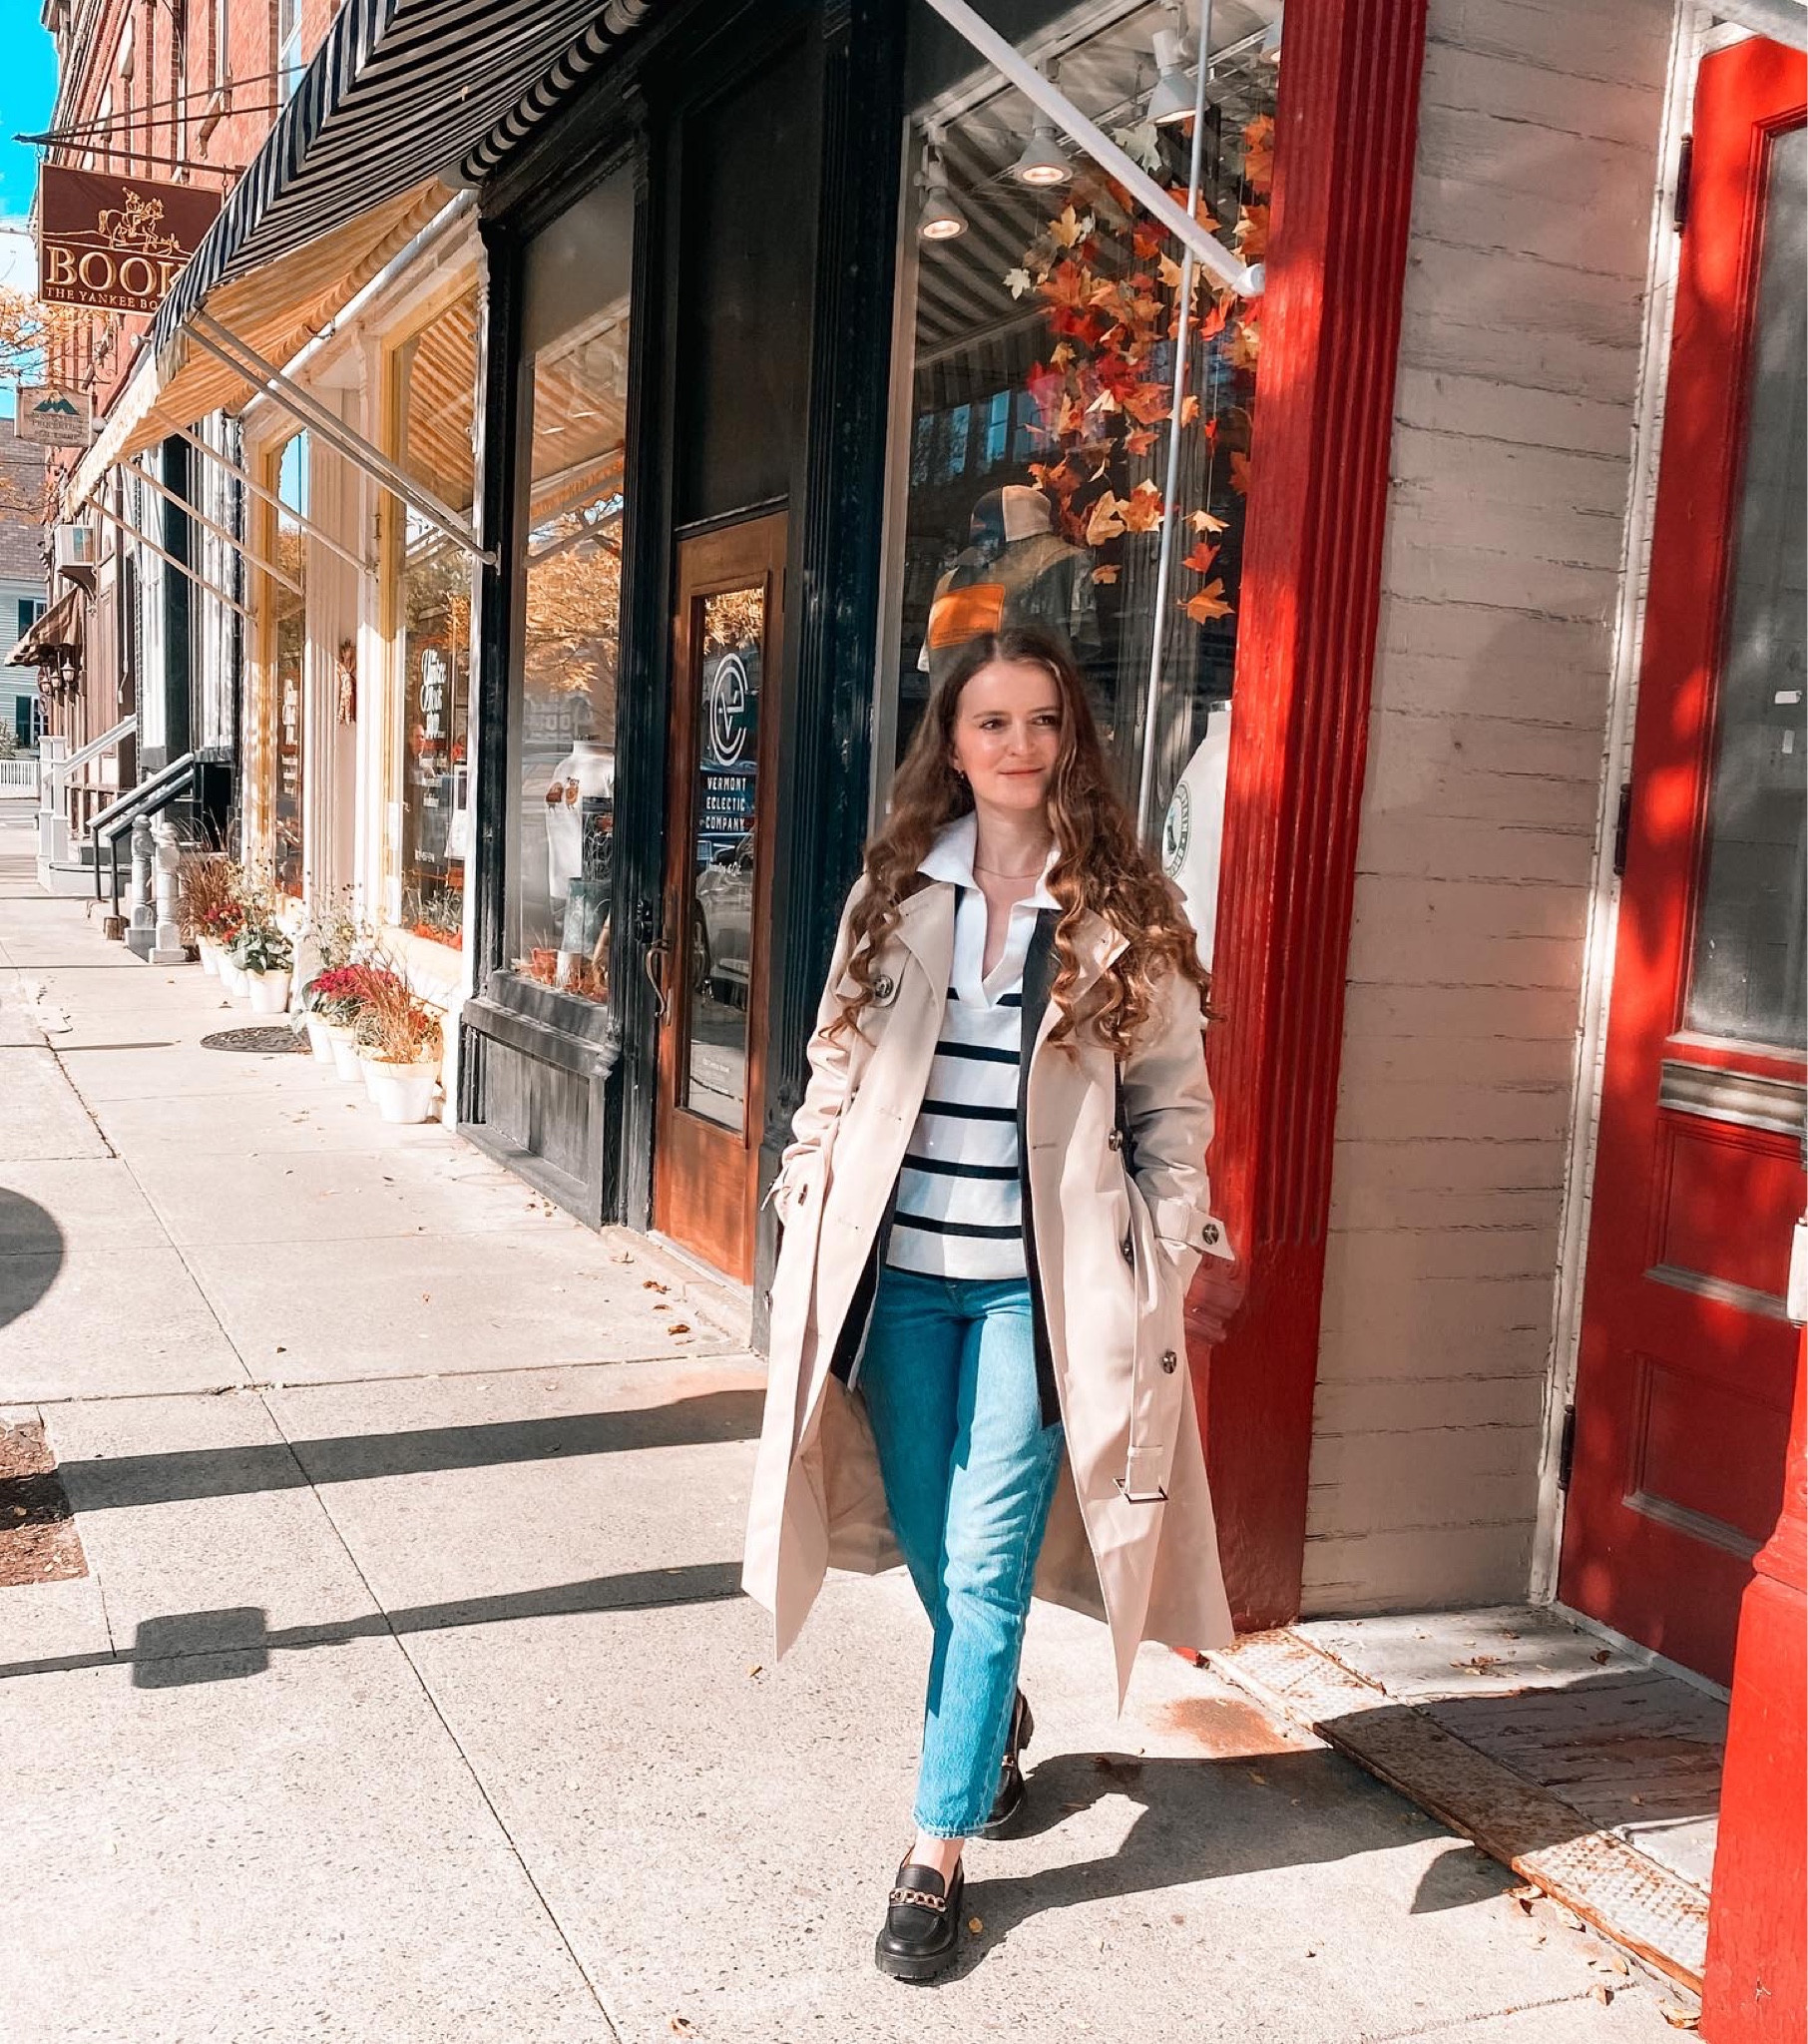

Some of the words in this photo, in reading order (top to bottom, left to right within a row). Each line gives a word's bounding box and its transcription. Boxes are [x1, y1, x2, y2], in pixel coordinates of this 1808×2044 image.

[46, 286, 75, 299] THE
[79, 290, 136, 308] YANKEE
[706, 776, 746, 791] VERMONT
[705, 796, 746, 812] ECLECTIC
[705, 815, 745, 831] COMPANY
